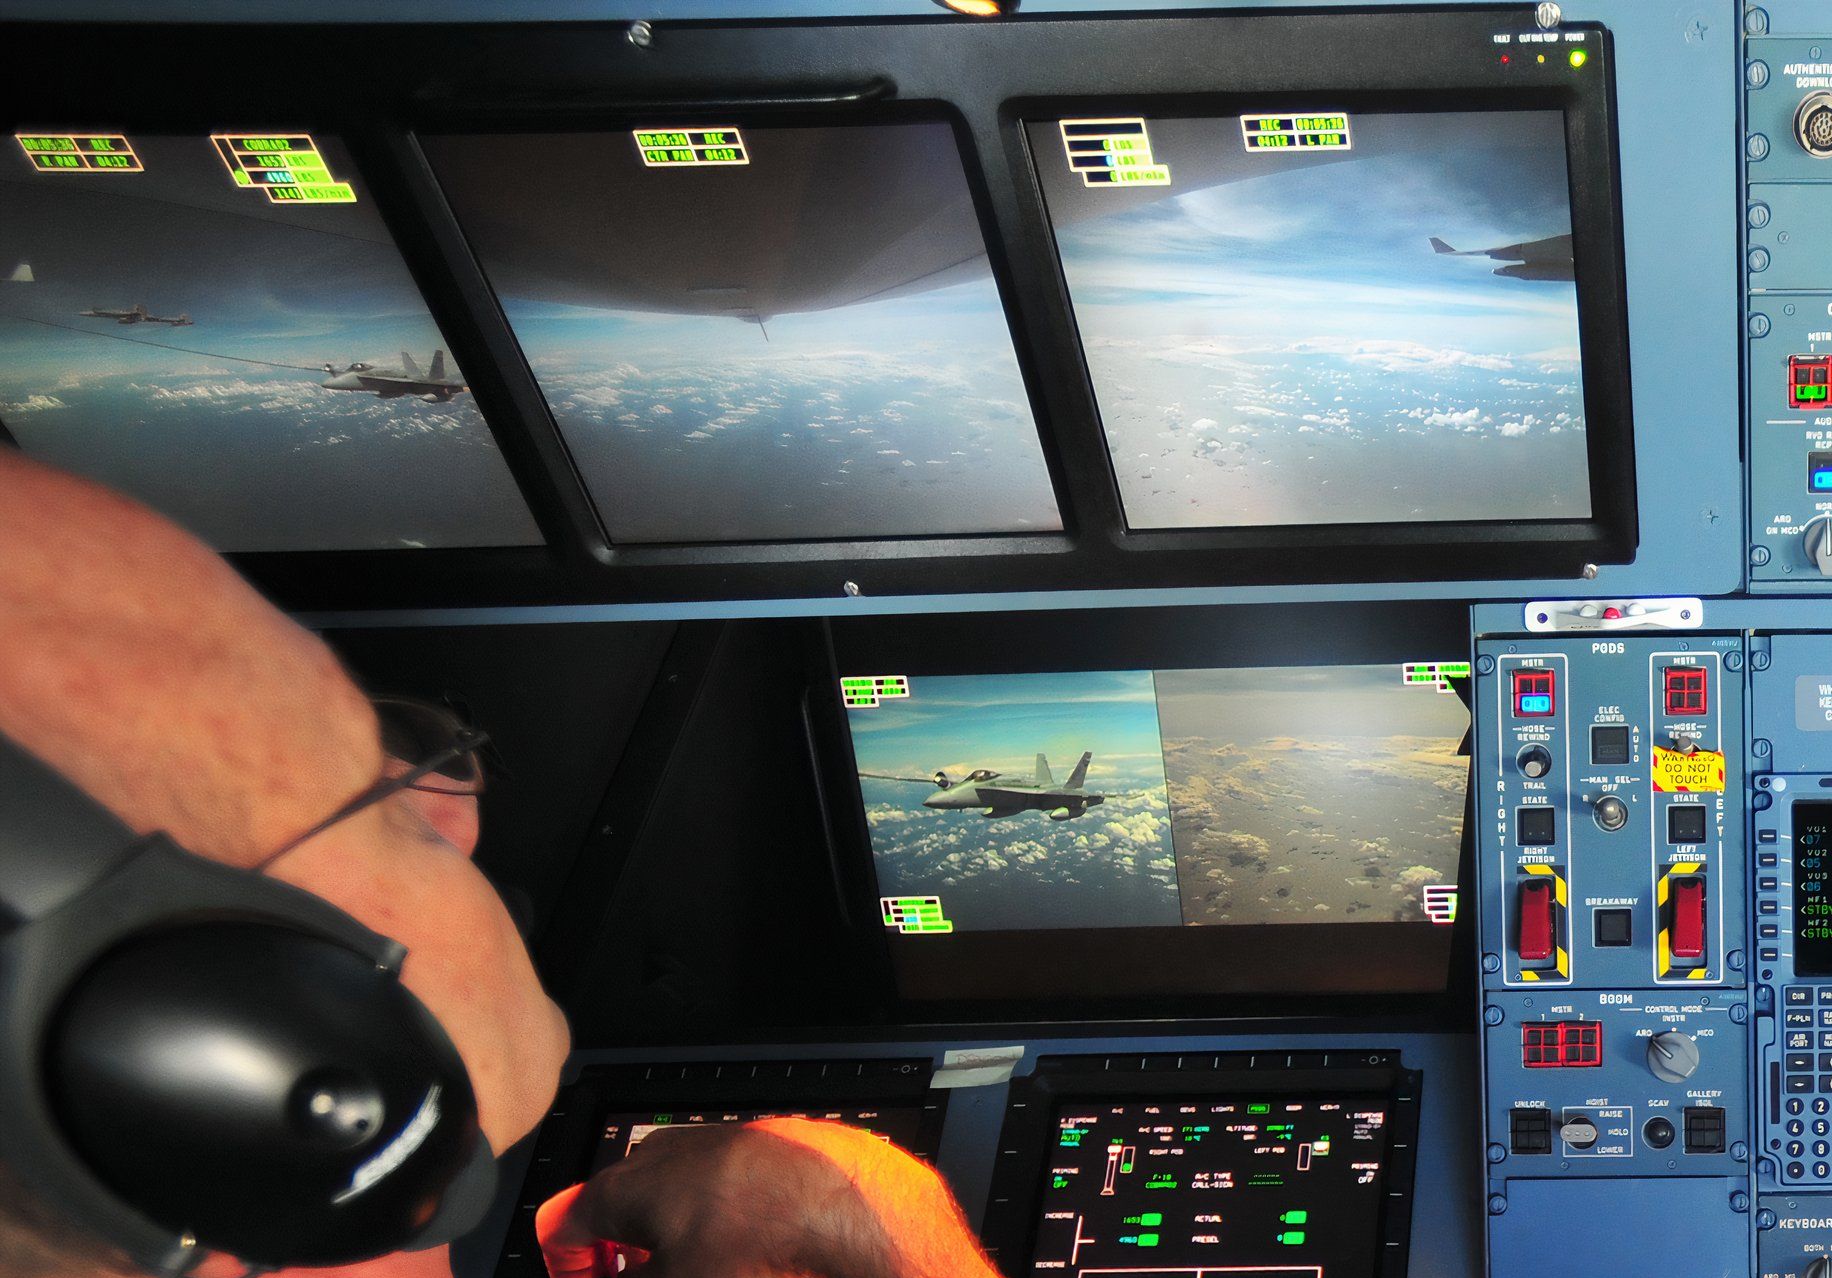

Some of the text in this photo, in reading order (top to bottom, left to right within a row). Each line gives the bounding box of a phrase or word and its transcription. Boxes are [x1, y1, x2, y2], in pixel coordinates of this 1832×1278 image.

[1592, 643, 1625, 654] PODS
[1665, 764, 1710, 772] DO NOT
[1670, 775, 1707, 783] TOUCH
[1517, 855, 1555, 863] JETTISON
[1600, 994, 1633, 1004] BOOM
[1787, 1014, 1810, 1022] F-PLN
[1818, 1101, 1824, 1112] 2
